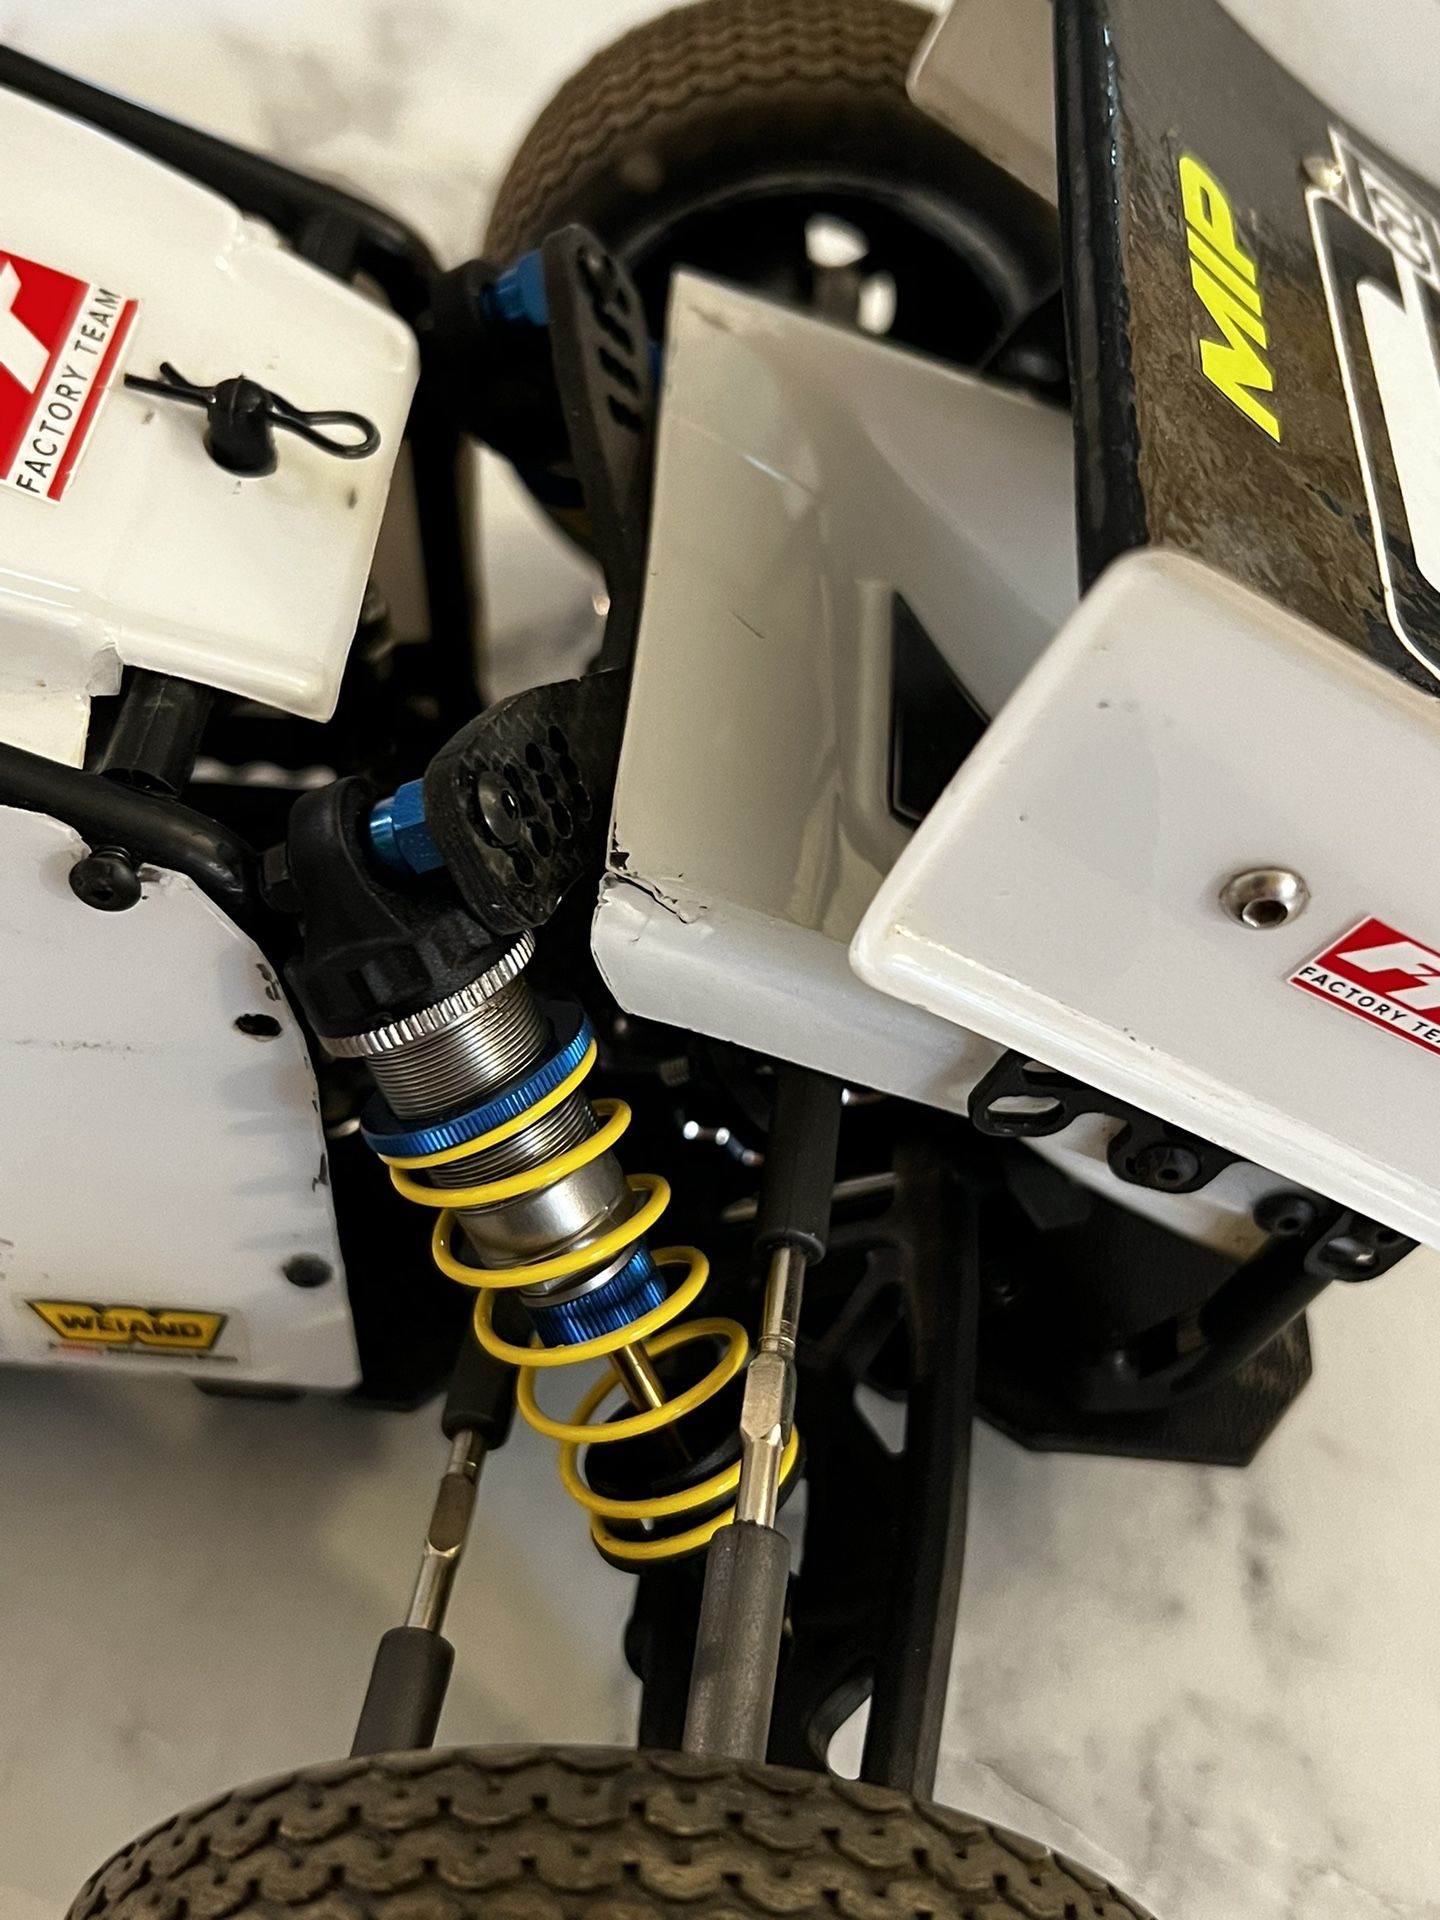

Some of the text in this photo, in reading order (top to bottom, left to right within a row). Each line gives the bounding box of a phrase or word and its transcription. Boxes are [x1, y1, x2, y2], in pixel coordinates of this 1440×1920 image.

[1179, 156, 1281, 443] MIP
[16, 288, 122, 493] FACTORY TEAM
[1298, 966, 1440, 1044] FACTORY TE
[59, 1313, 203, 1338] WEIAND
